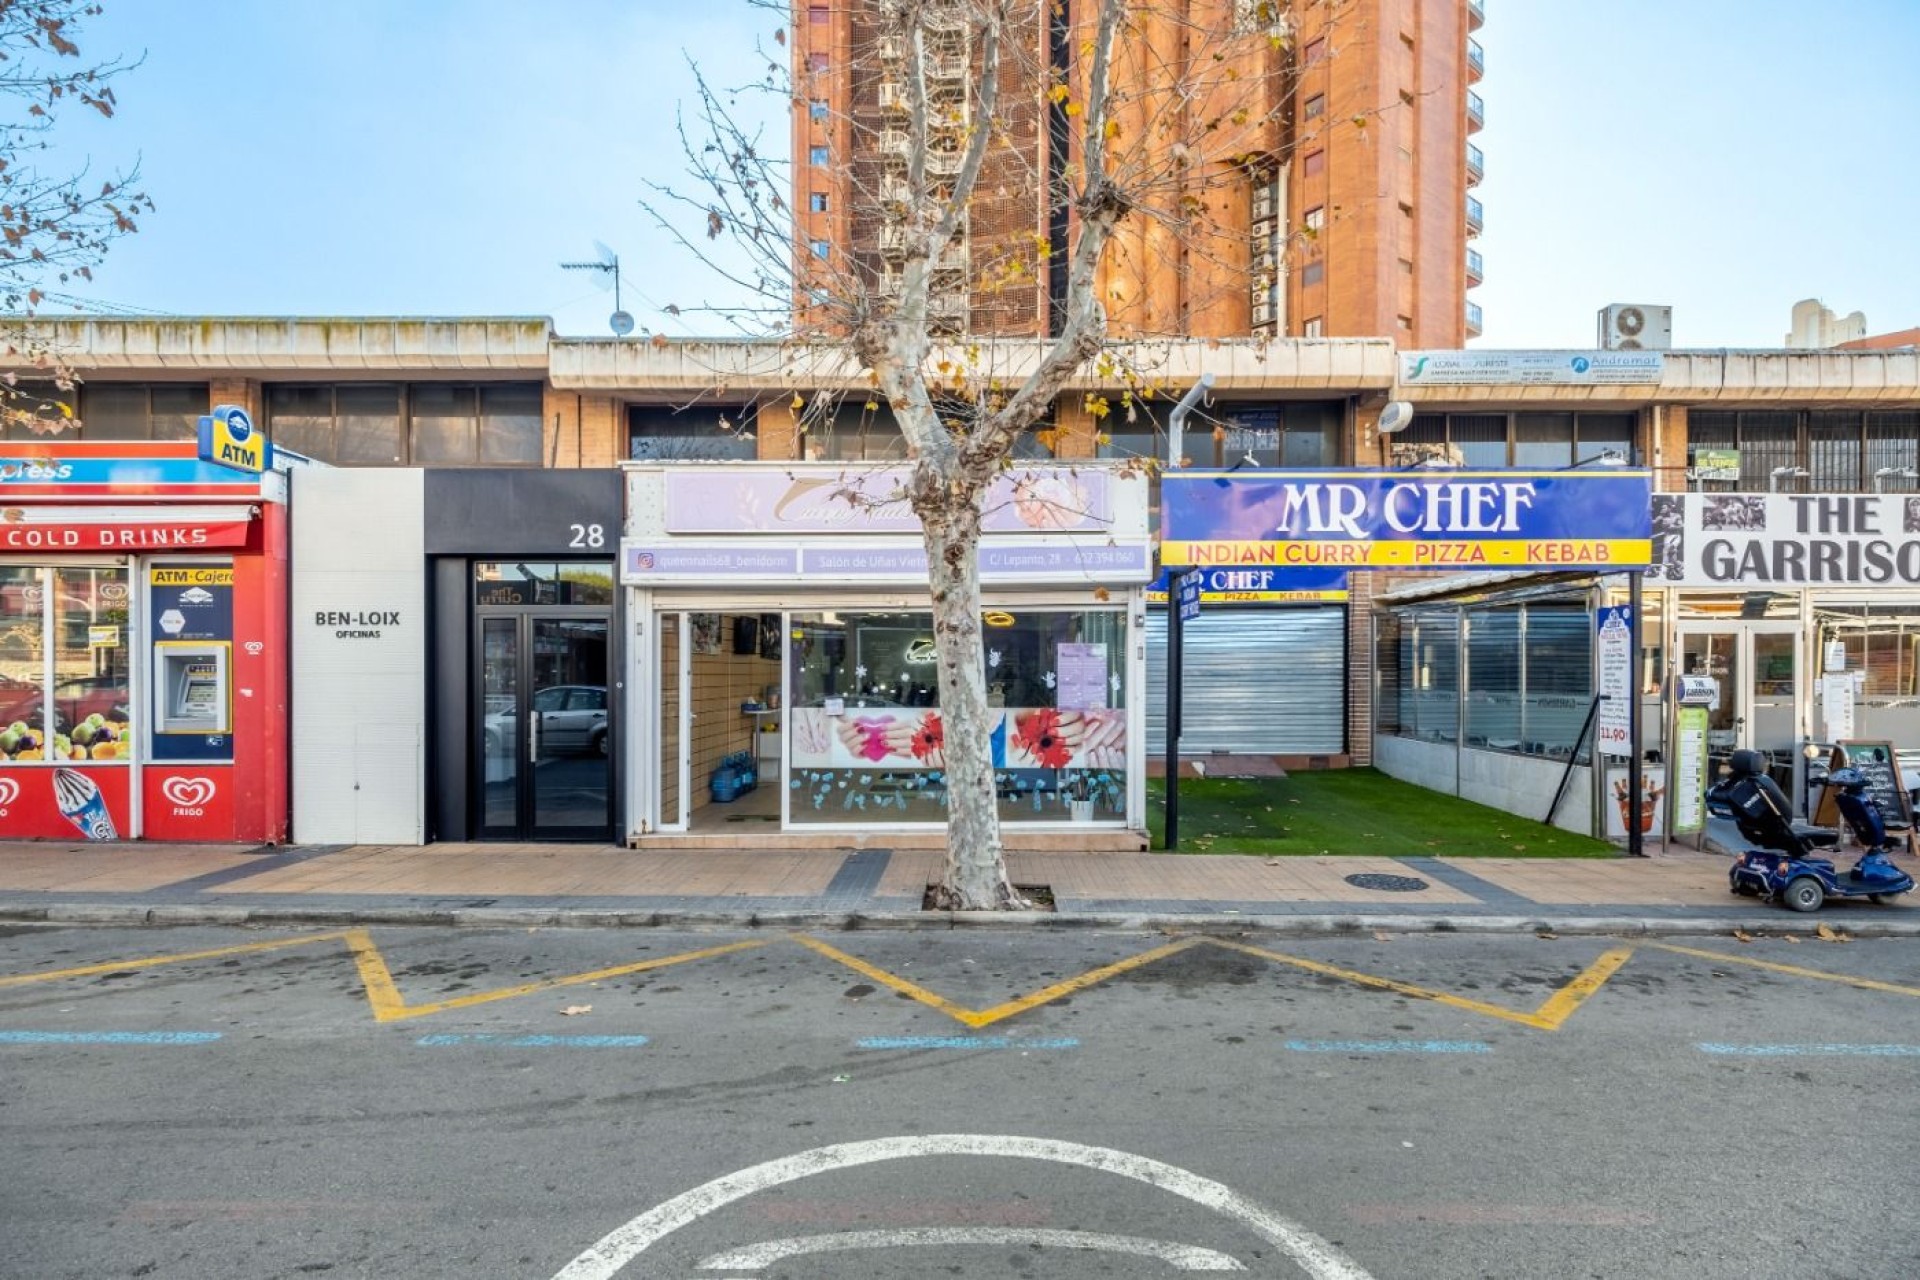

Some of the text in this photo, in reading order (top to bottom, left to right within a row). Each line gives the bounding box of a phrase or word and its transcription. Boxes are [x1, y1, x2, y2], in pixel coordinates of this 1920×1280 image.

[221, 442, 256, 467] ATM
[1276, 482, 1537, 539] MR CHEF
[1789, 496, 1882, 535] THE
[7, 528, 207, 546] COLD DRINKS
[568, 523, 604, 548] 28
[1187, 543, 1610, 563] INDIAN CURRY PIZZA KEBAB
[155, 571, 188, 582] ATM
[1211, 571, 1273, 589] CHEF
[315, 612, 400, 625] BEN-LOIX
[336, 630, 380, 638] OFICINAS
[173, 808, 203, 816] FRIGO
